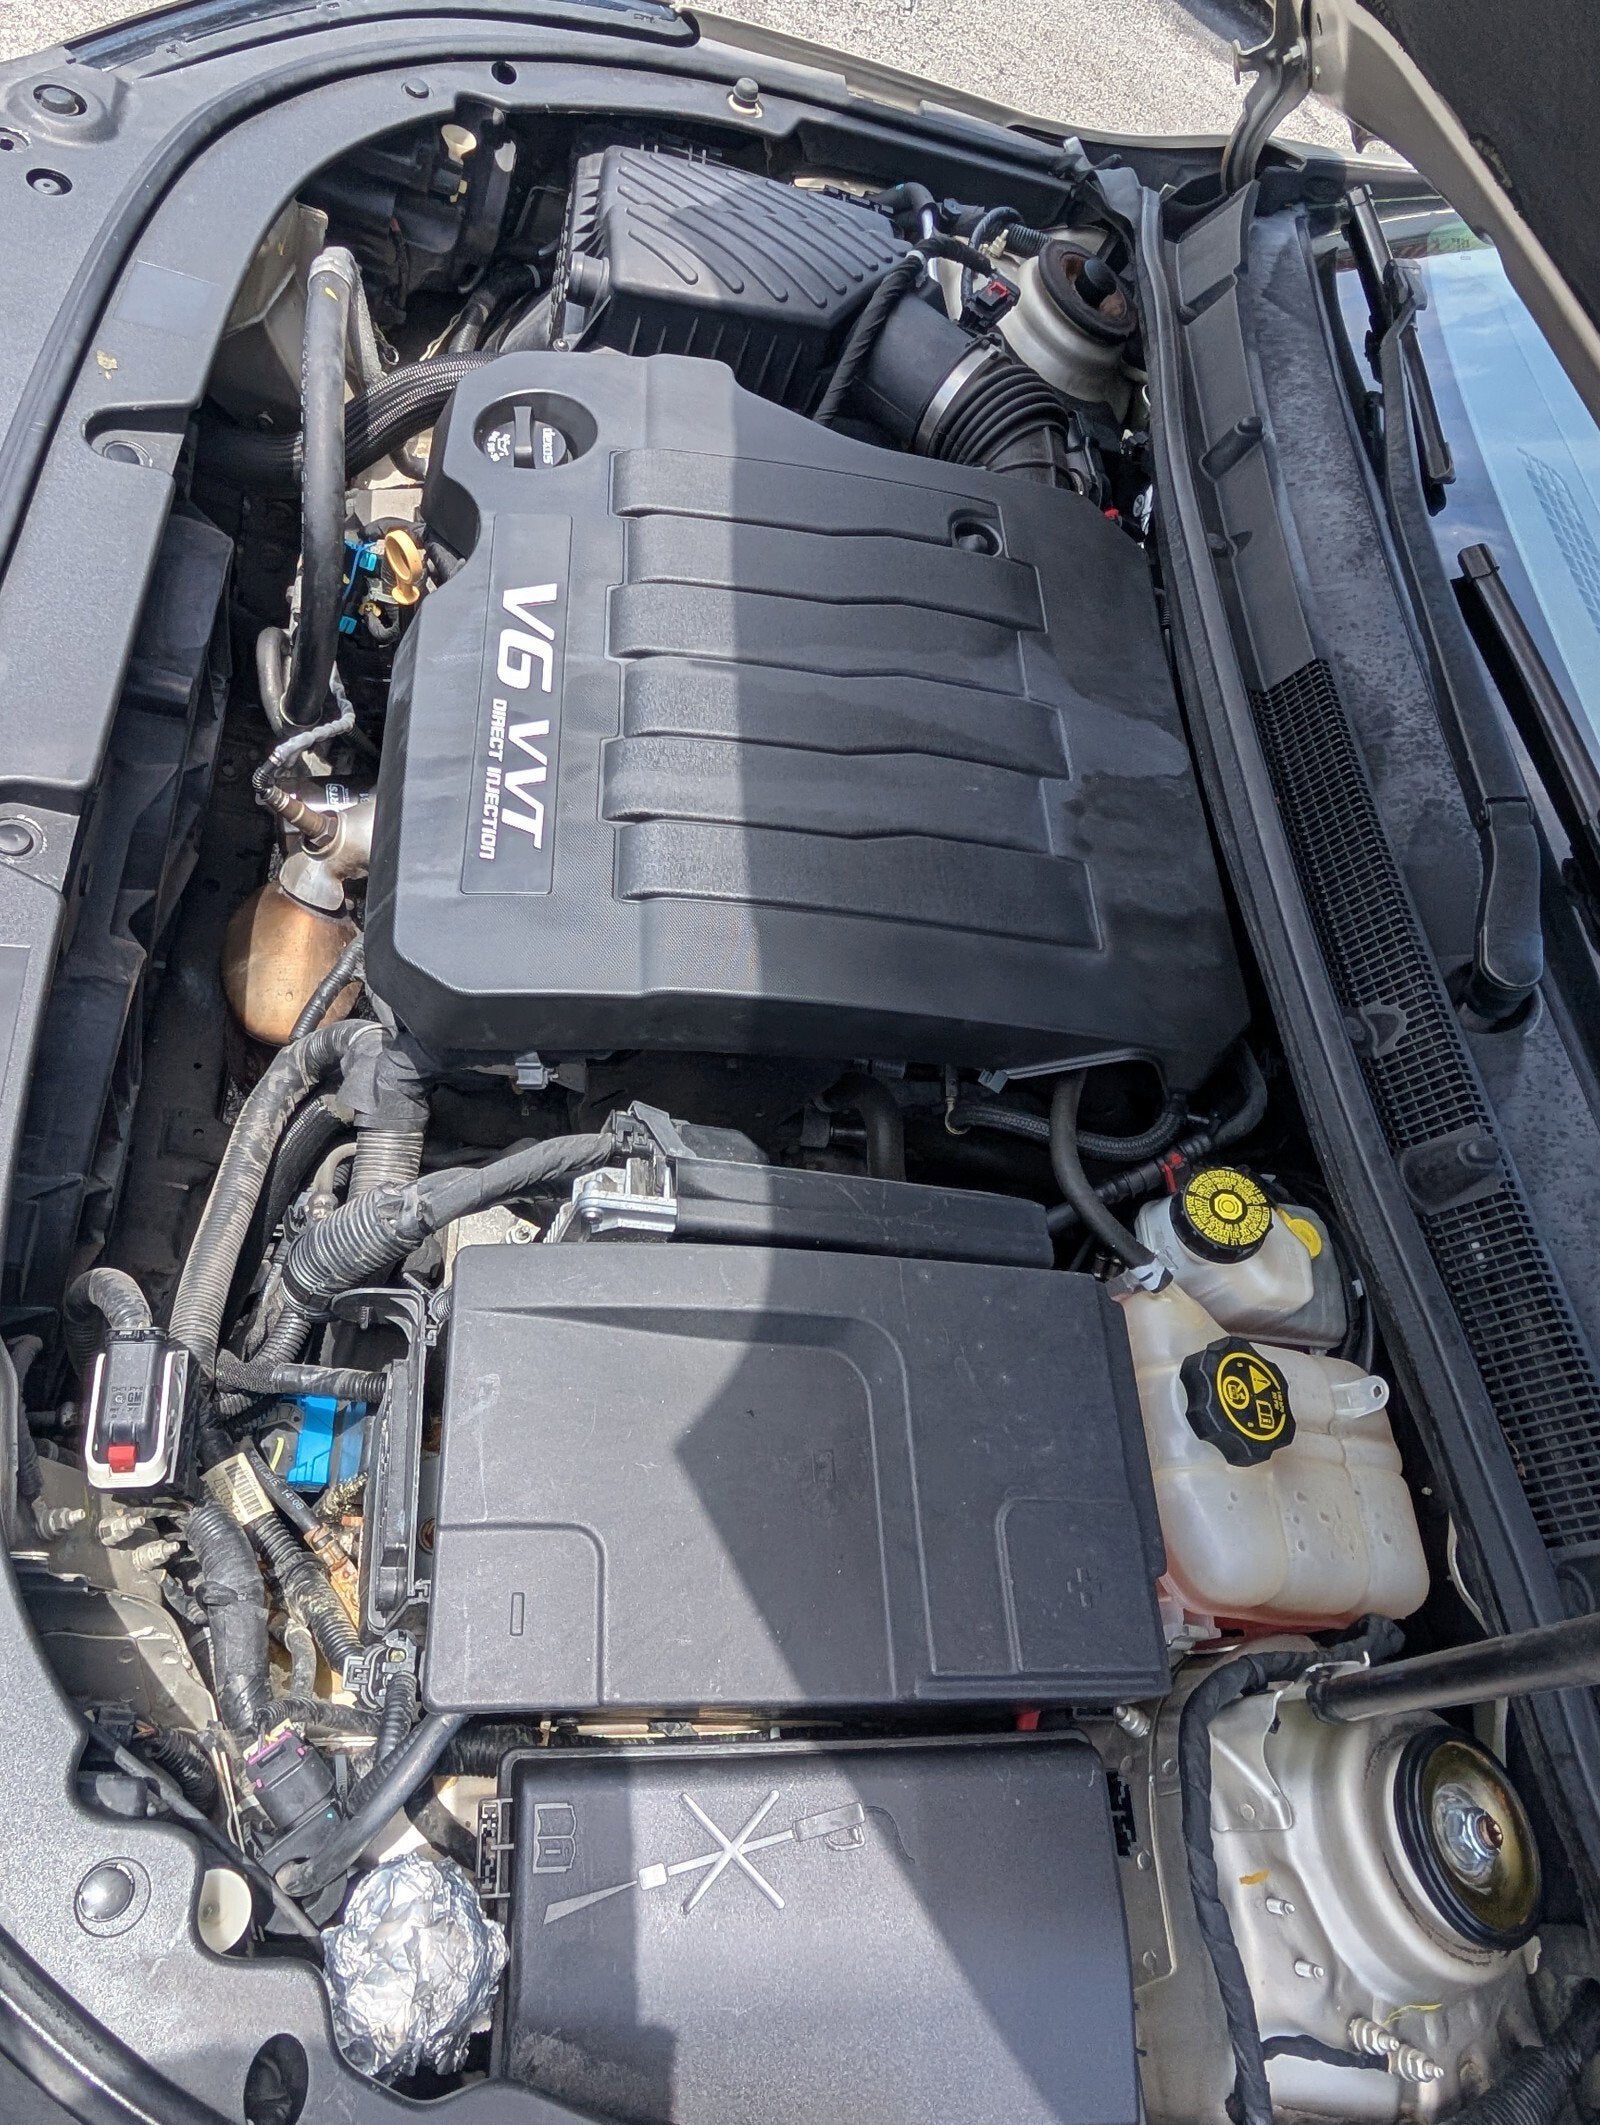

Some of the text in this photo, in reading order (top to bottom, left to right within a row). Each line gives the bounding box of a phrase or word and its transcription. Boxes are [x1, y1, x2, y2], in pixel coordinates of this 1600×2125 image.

[542, 428, 555, 464] dexos
[496, 582, 558, 853] V6 VVT
[479, 698, 508, 860] DIRECT INJECTION
[128, 1392, 142, 1402] GM
[282, 1489, 305, 1511] 14:08
